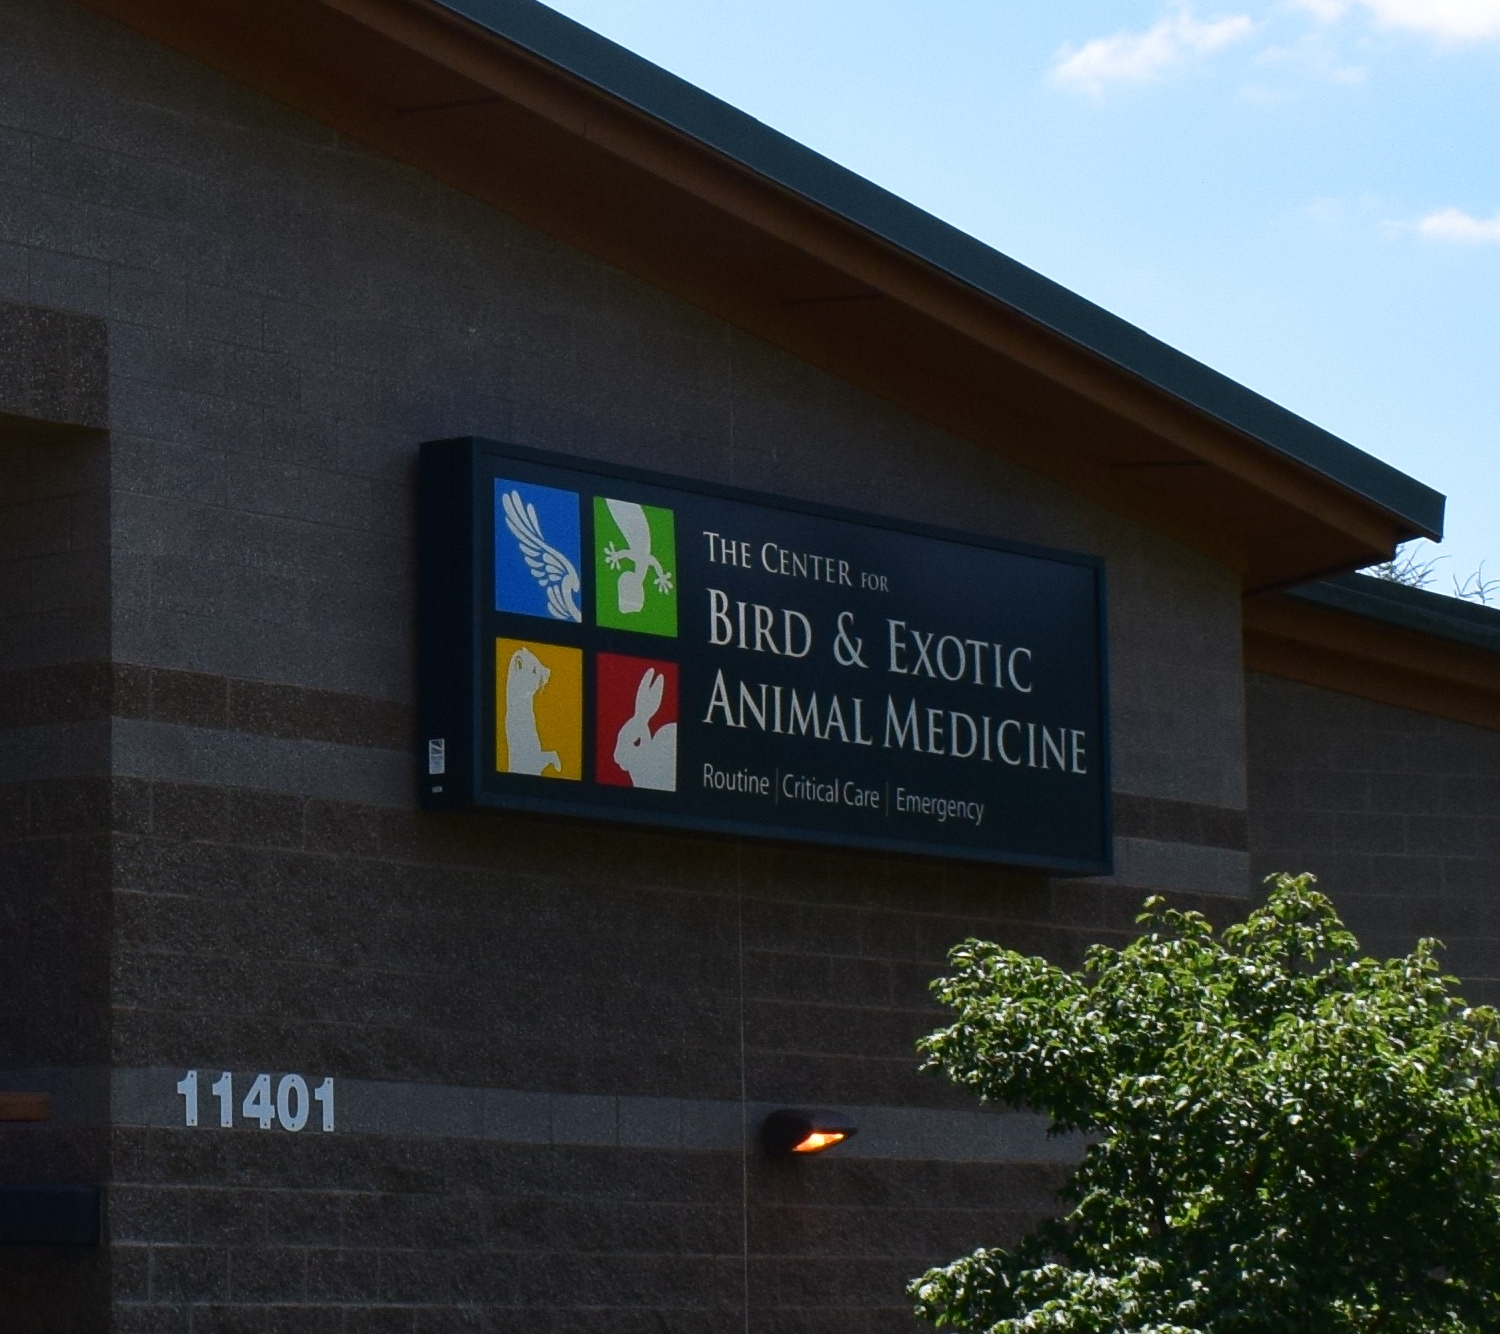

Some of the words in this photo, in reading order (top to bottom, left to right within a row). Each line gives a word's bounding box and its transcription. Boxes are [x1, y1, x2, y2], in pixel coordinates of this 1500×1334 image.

[705, 588, 812, 658] BIRD
[833, 611, 869, 668] &
[886, 618, 1033, 693] EXOTIC
[702, 668, 873, 746] ANIMAL
[882, 693, 1088, 775] MEDICINE
[703, 763, 770, 795] Routine
[782, 773, 839, 804] Critical
[843, 782, 880, 809] Care
[896, 787, 985, 826] Emergency
[177, 1070, 335, 1132] 11401
